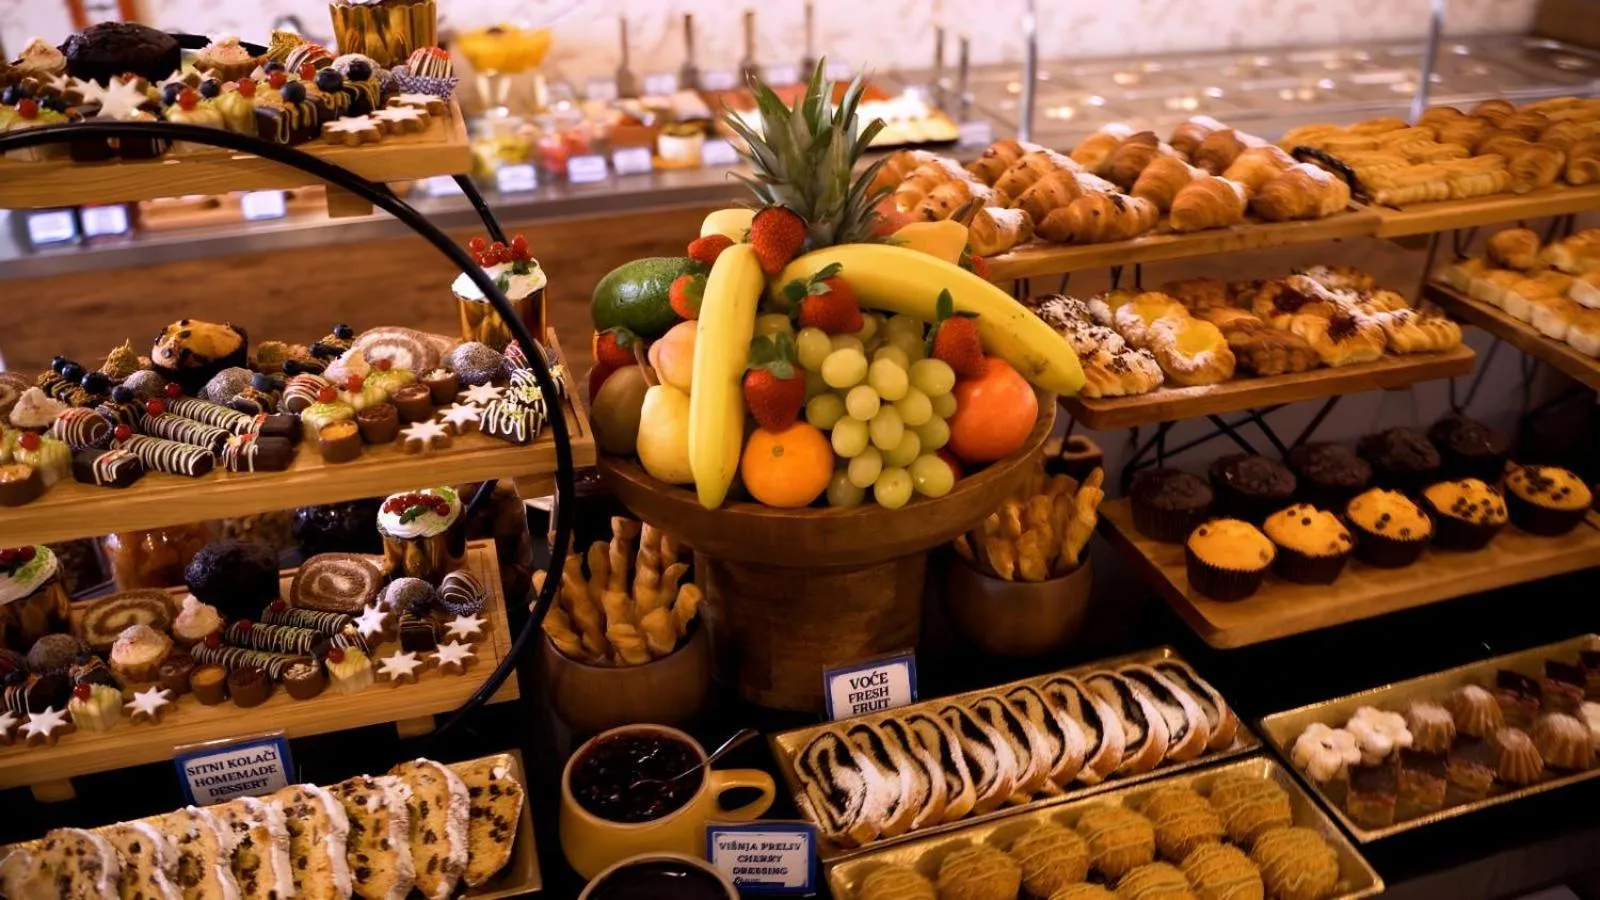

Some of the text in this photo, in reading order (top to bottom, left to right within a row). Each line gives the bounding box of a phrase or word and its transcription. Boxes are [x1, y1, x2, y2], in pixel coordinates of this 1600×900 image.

[849, 670, 889, 690] VOĆE
[848, 686, 890, 703] FRESH
[852, 698, 891, 714] FRUIT
[186, 750, 277, 776] SITNI KOLAČI
[194, 764, 278, 788] HOMEMADE
[209, 778, 269, 796] DESSERT
[732, 866, 789, 875] DRESSING
